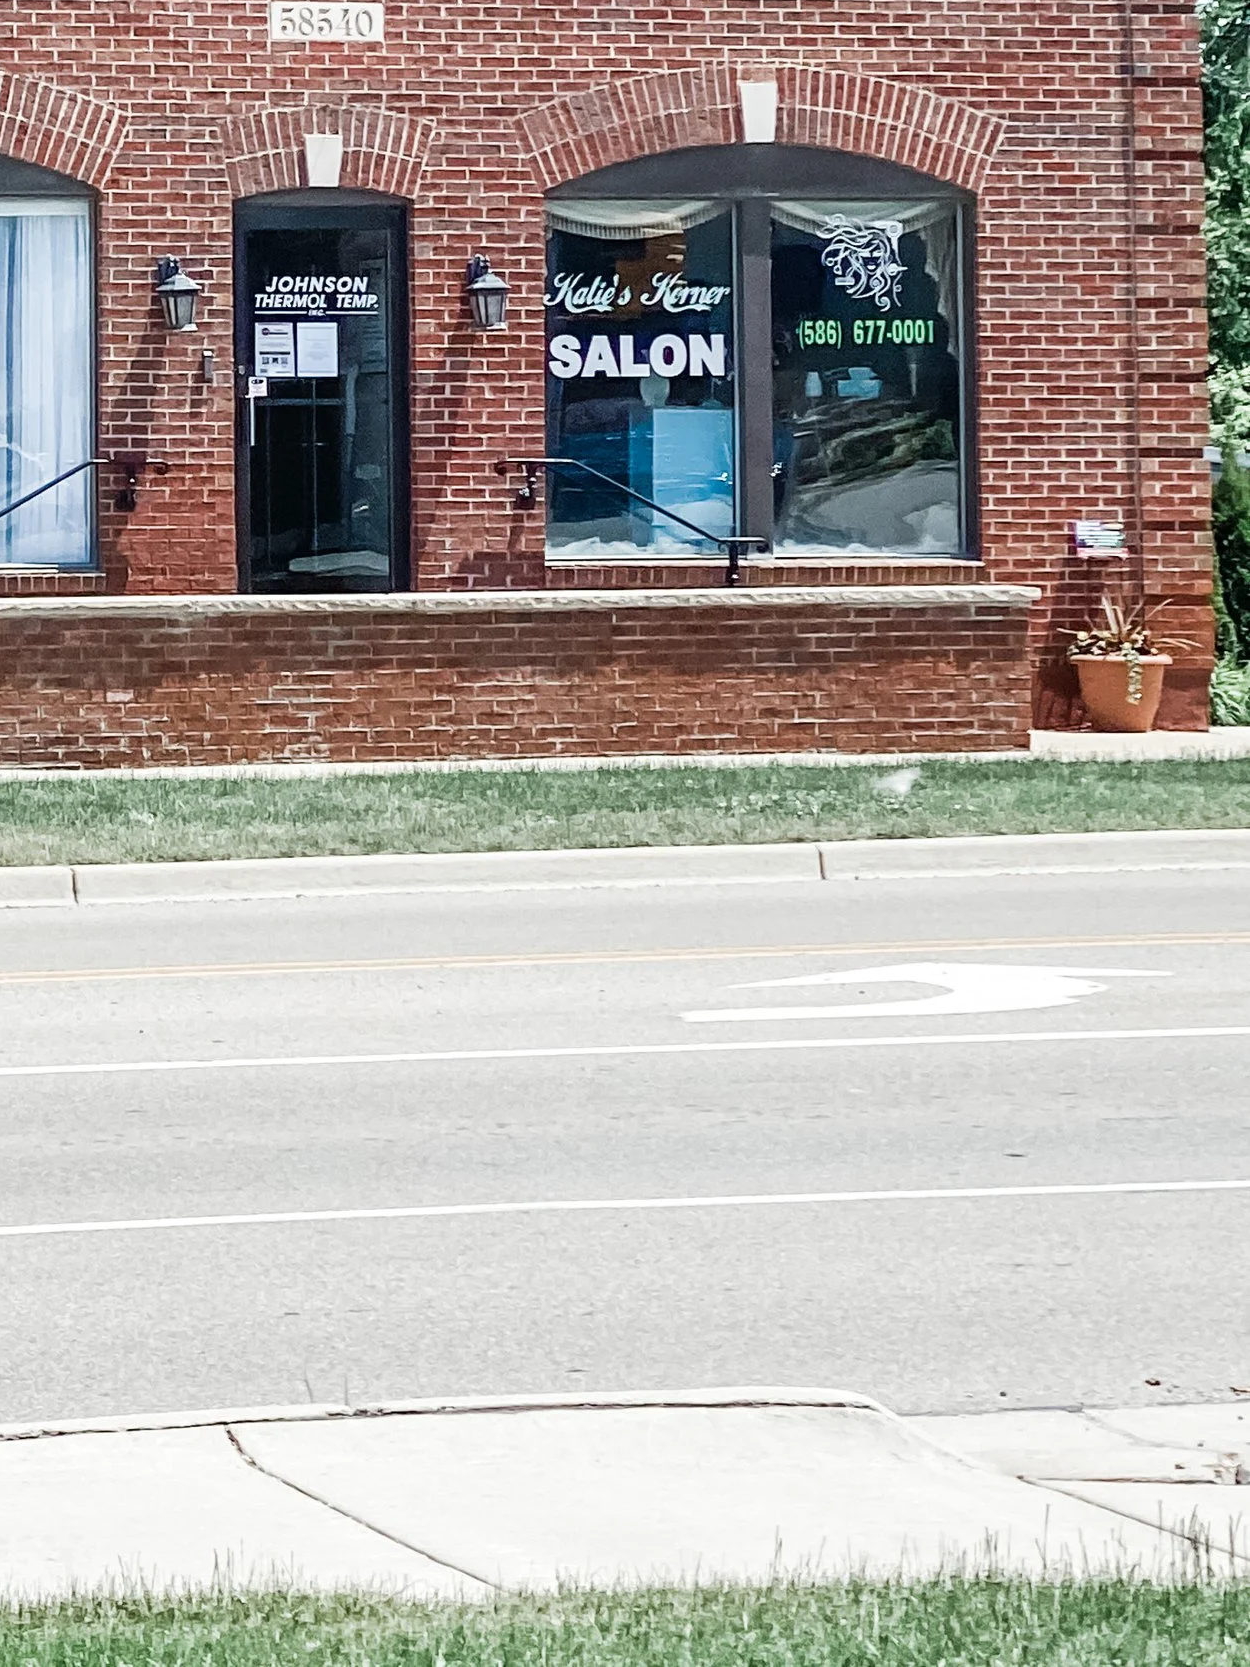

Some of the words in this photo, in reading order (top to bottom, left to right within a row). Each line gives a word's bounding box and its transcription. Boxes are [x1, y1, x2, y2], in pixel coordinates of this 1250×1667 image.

[281, 7, 373, 37] 58540
[265, 276, 368, 292] JOHNSON
[543, 272, 632, 314] Katie's
[640, 272, 731, 312] Korner
[255, 294, 327, 308] THERMOL
[336, 295, 378, 308] TEMP.
[799, 320, 842, 350] (586)
[853, 320, 934, 344] 677-0001
[549, 334, 725, 378] SALON
